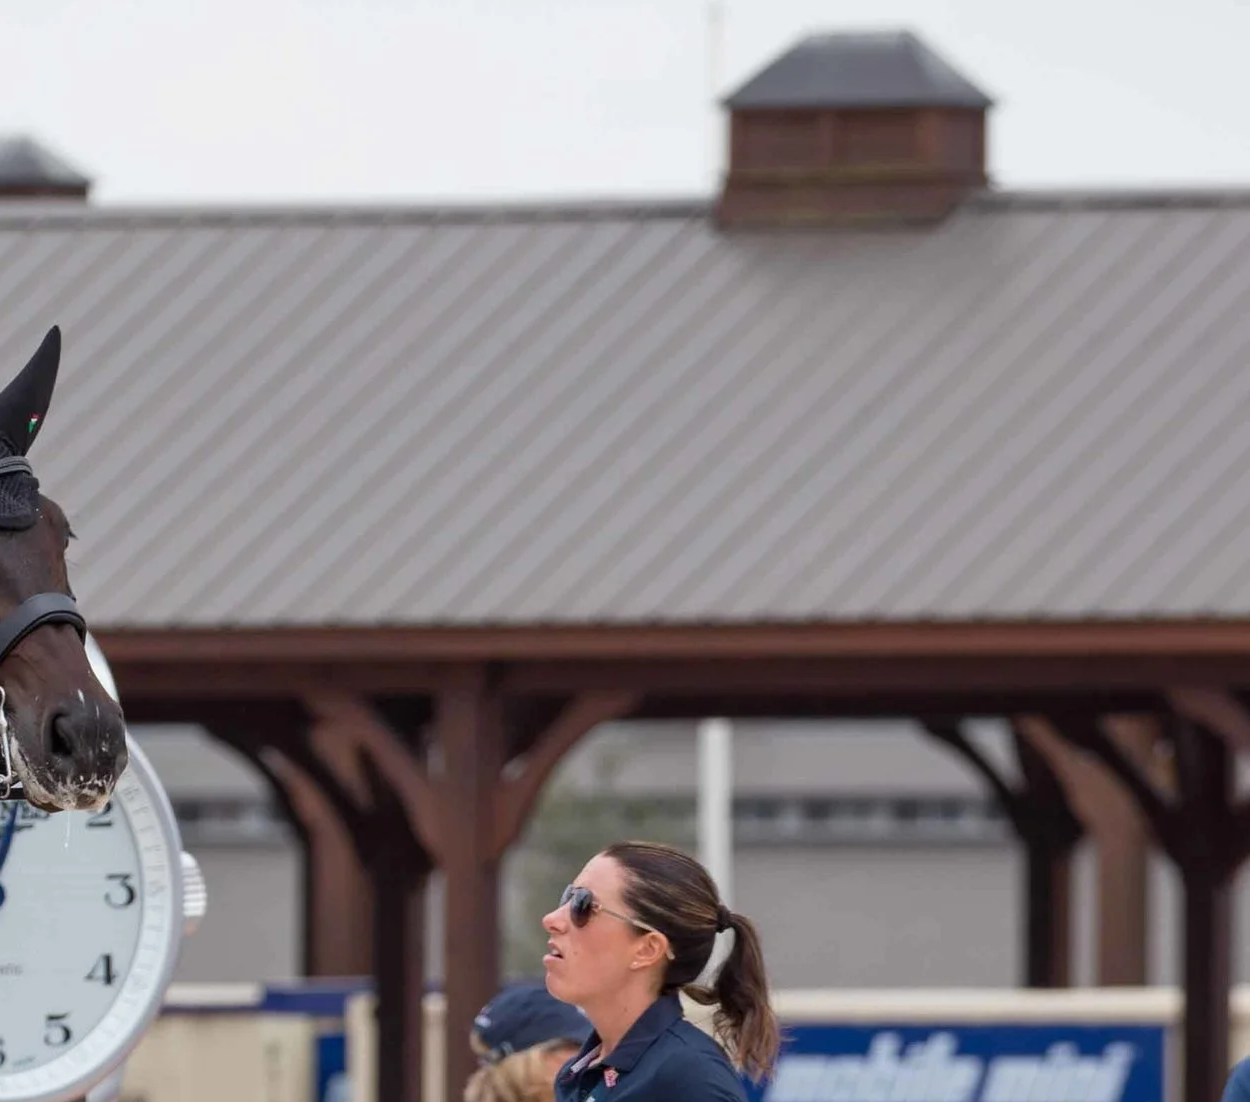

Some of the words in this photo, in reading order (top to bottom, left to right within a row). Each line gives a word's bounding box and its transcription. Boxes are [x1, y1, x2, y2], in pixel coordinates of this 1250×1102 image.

[103, 872, 137, 909] 3
[84, 953, 118, 986] 4
[43, 1012, 72, 1047] 5
